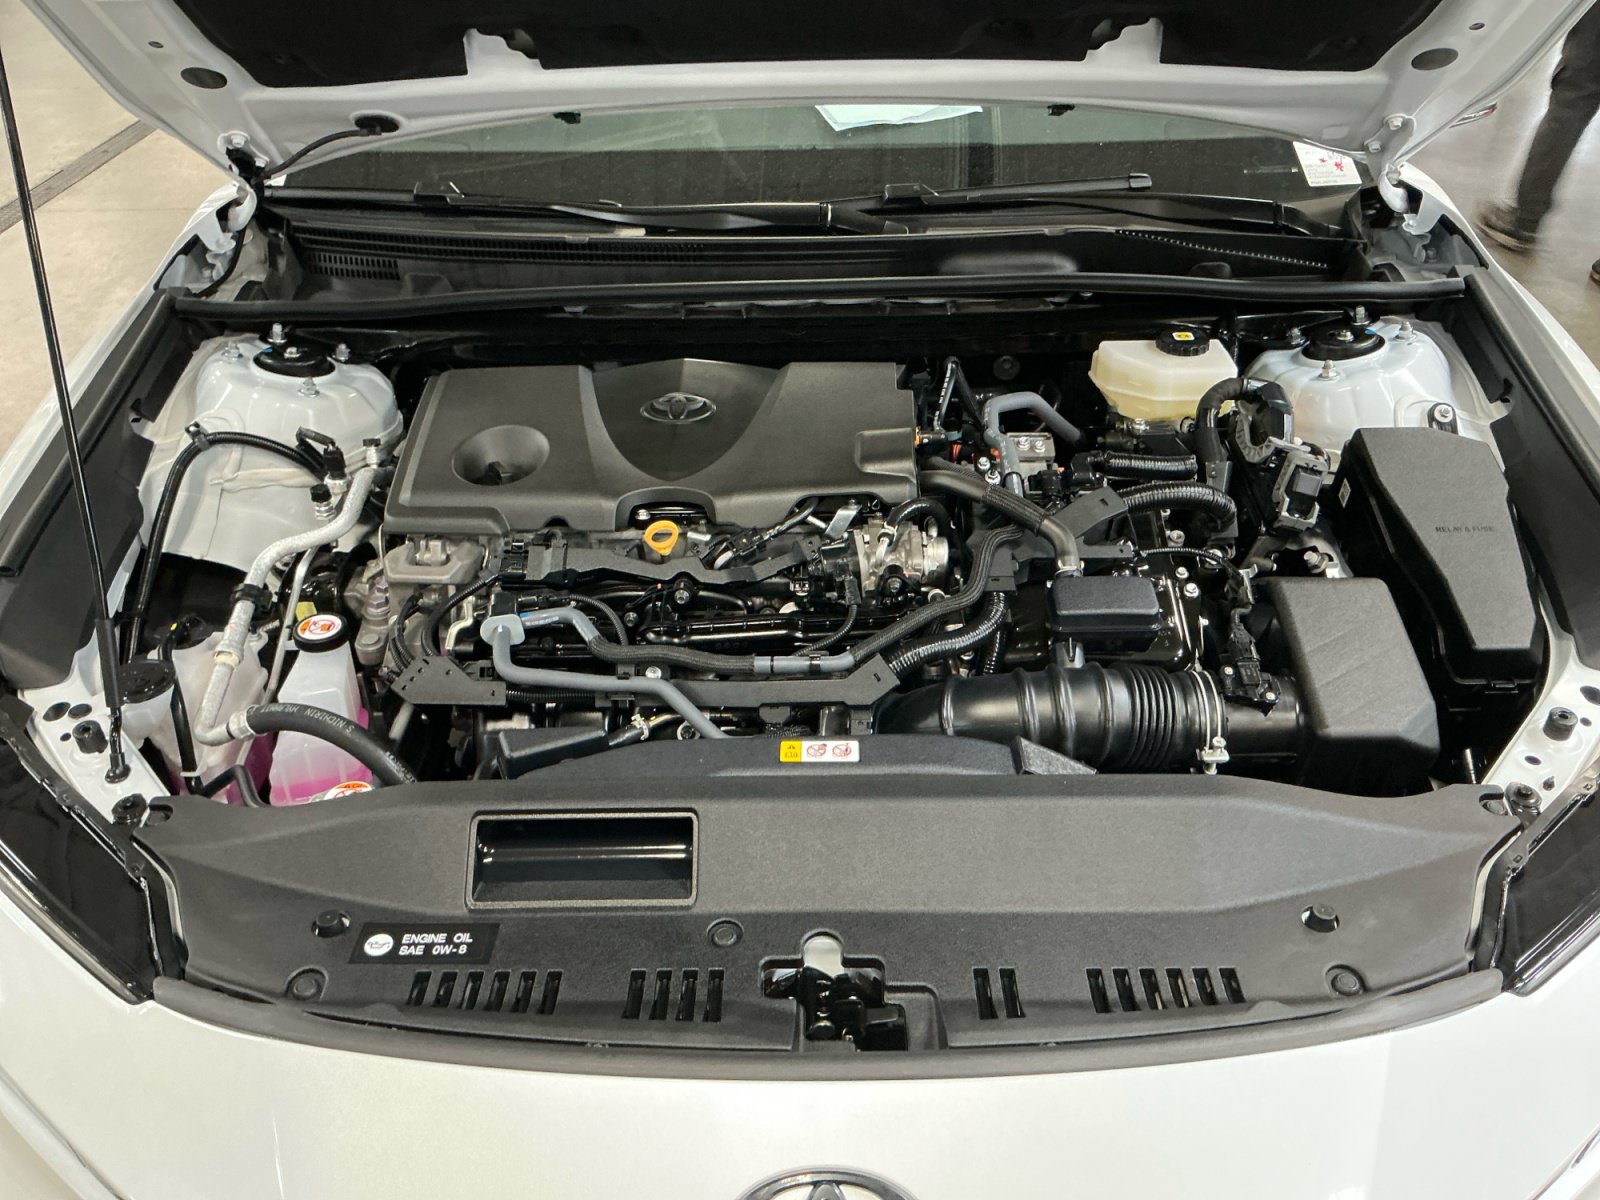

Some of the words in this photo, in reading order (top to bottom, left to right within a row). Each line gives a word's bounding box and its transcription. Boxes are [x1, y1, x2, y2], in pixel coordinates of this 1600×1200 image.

[401, 933, 447, 944] ENGINE
[453, 932, 473, 943] OIL
[398, 945, 425, 955] SAE
